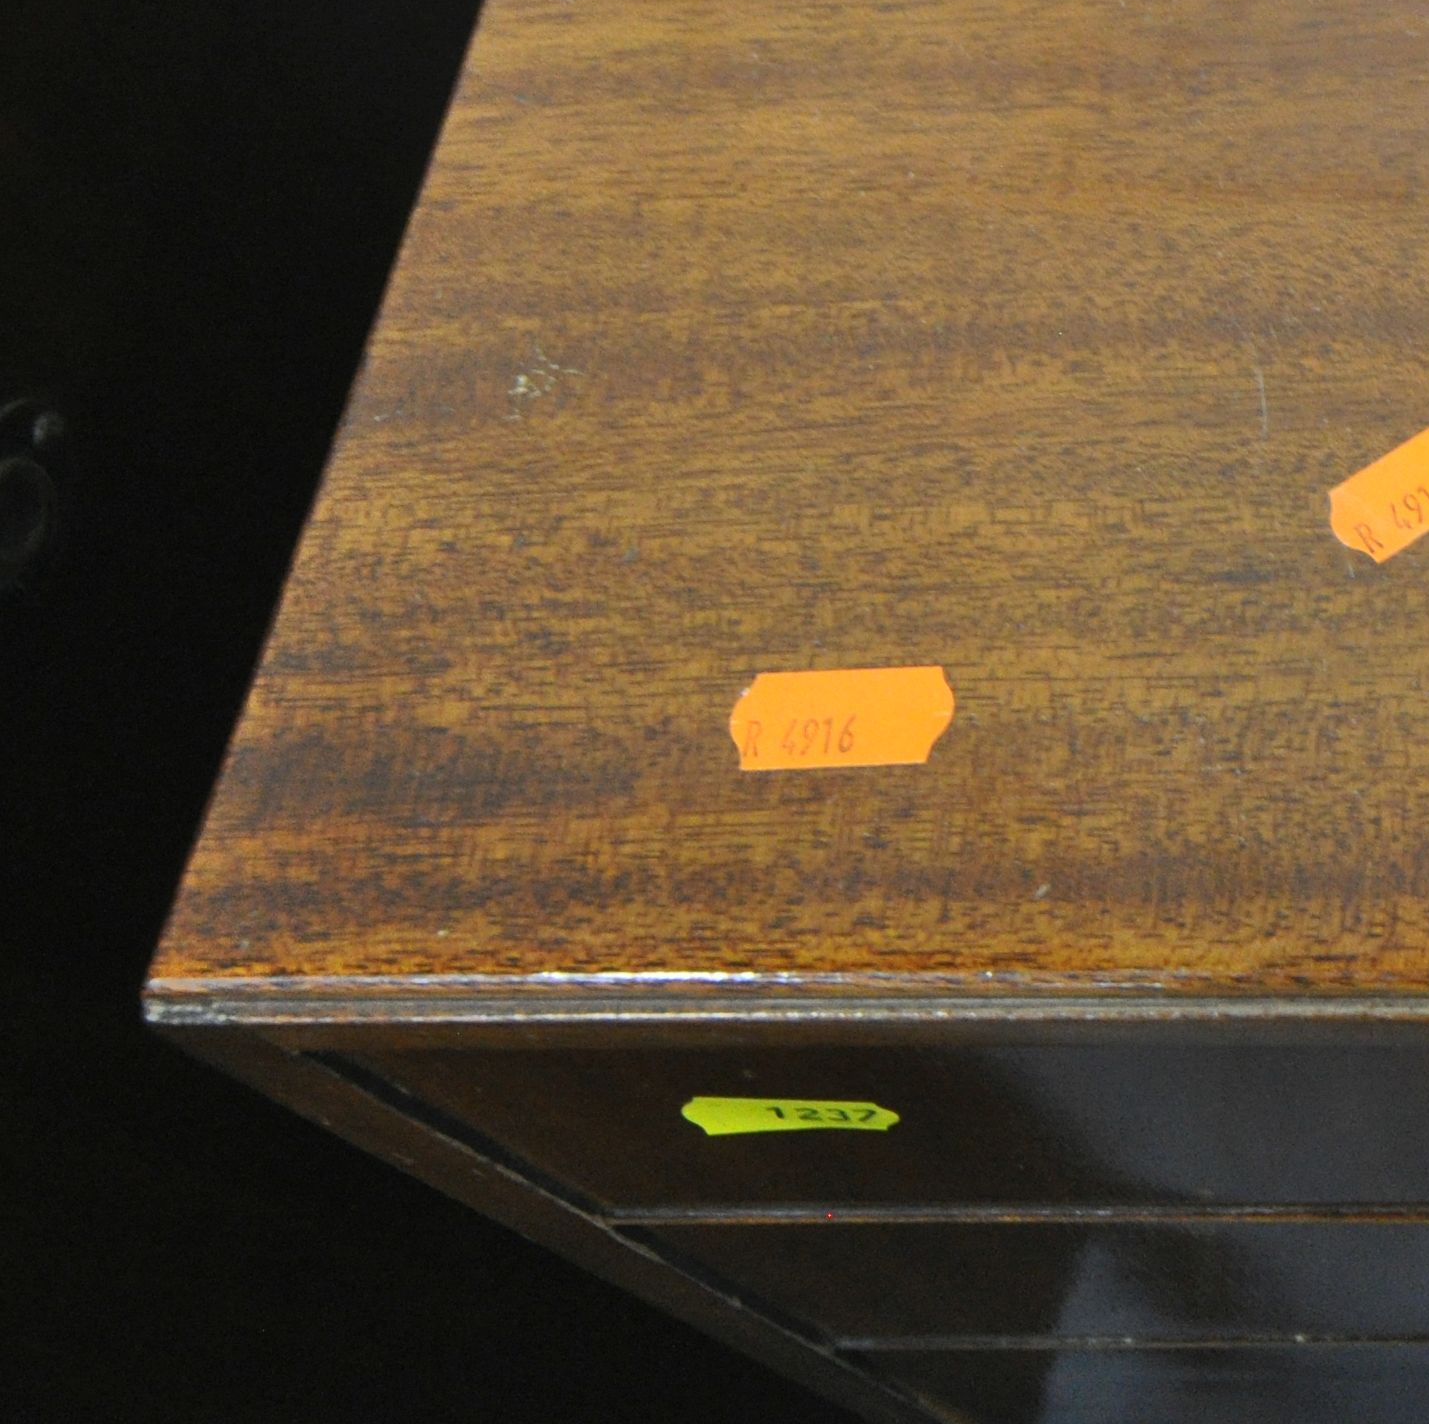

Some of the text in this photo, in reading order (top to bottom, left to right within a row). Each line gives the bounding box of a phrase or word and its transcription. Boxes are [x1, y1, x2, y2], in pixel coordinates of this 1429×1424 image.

[1355, 523, 1384, 554] R
[742, 713, 857, 758] R 4916
[766, 1106, 877, 1122] 1237
